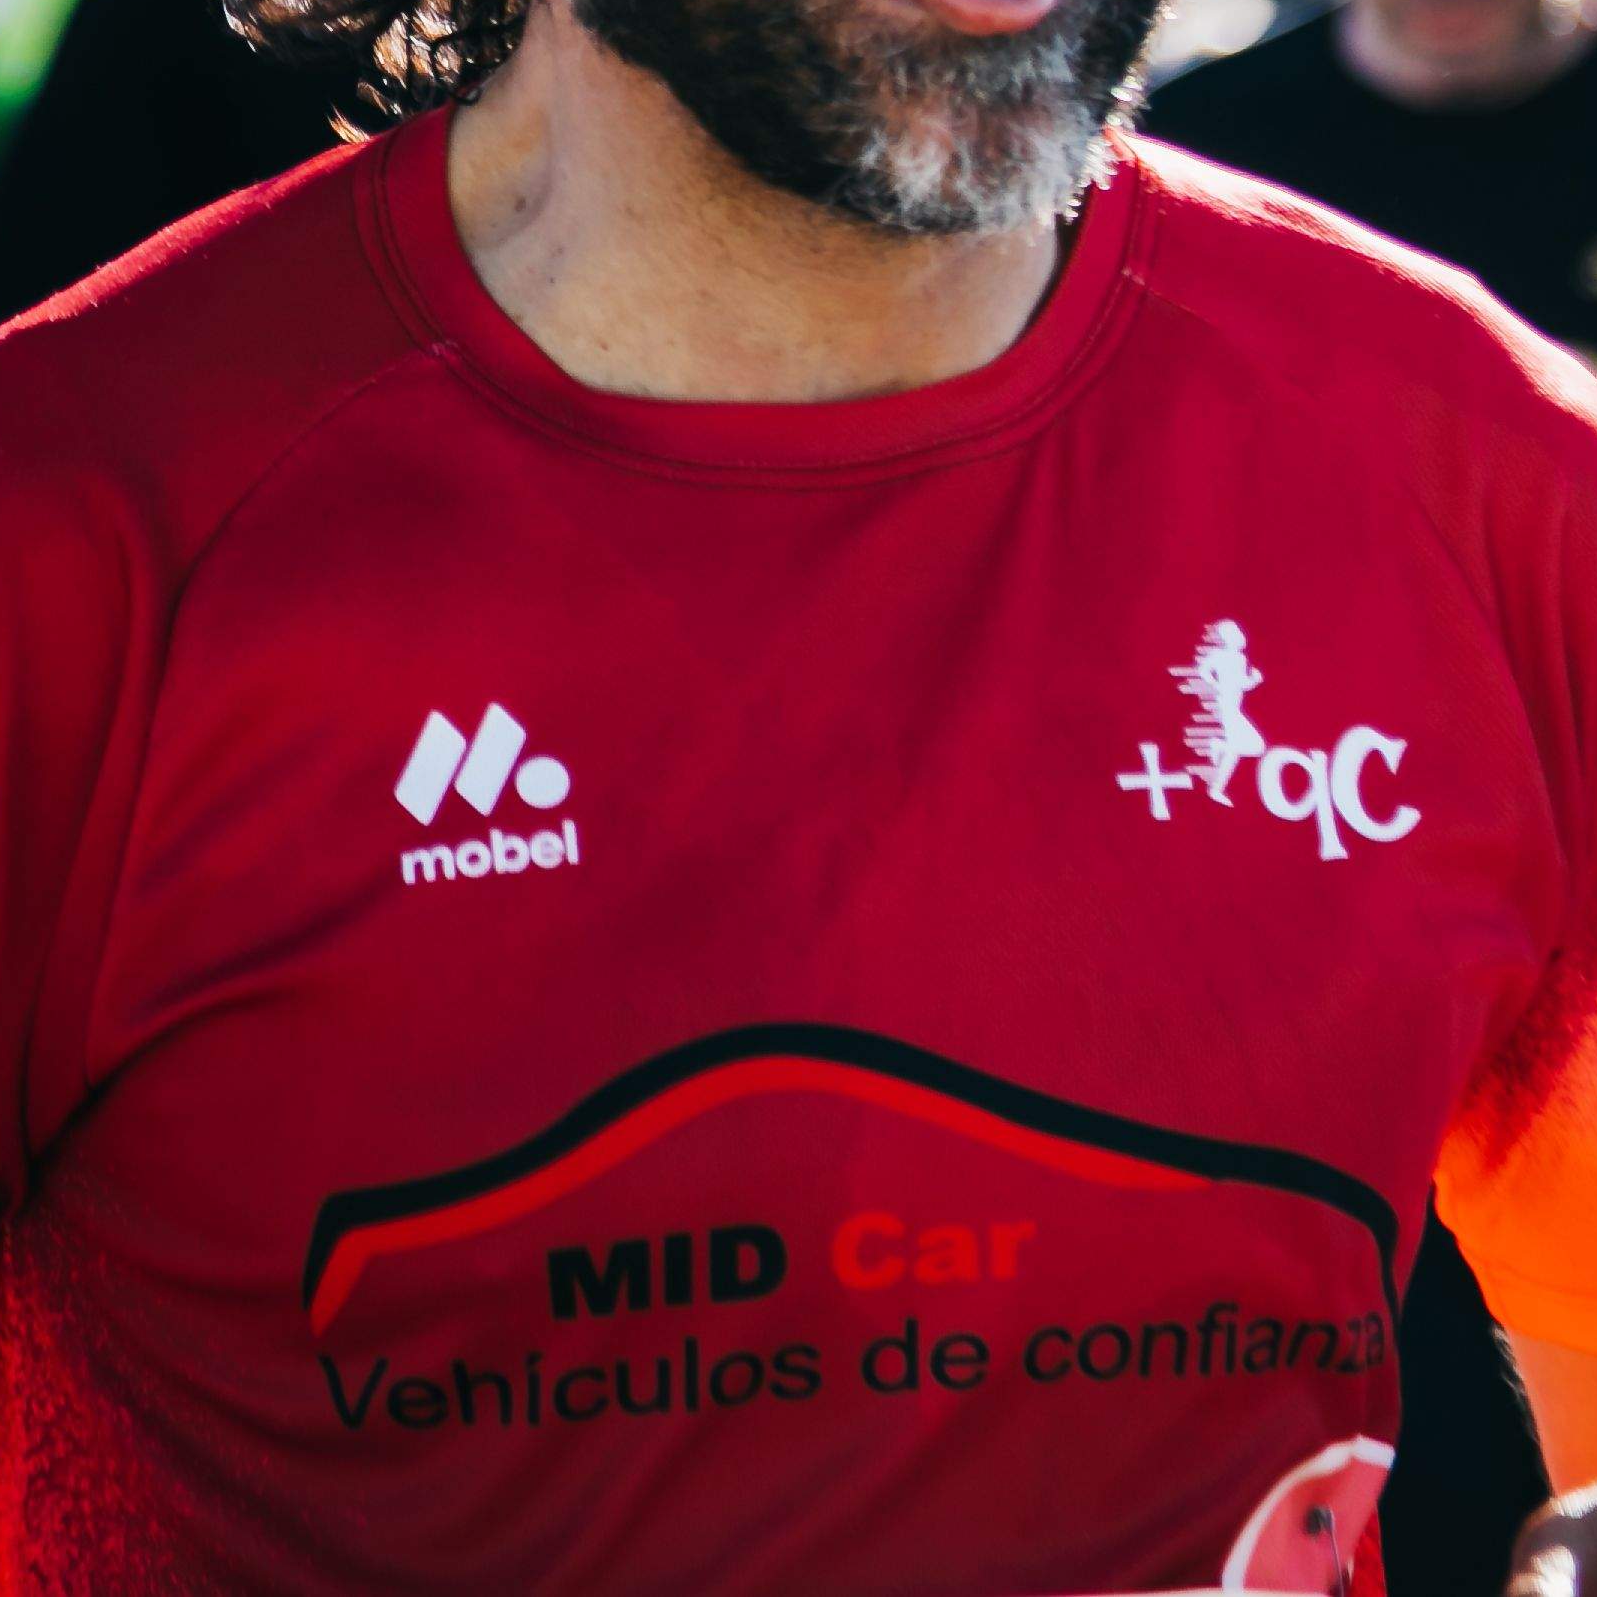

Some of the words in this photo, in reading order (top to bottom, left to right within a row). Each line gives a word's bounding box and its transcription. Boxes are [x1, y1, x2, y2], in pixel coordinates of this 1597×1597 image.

[400, 817, 580, 887] mobel
[548, 1224, 788, 1321] MID
[829, 1210, 1039, 1291] Car
[317, 1335, 824, 1430] Vehículos
[859, 1317, 992, 1396] de
[1022, 1301, 1386, 1384] confianza
